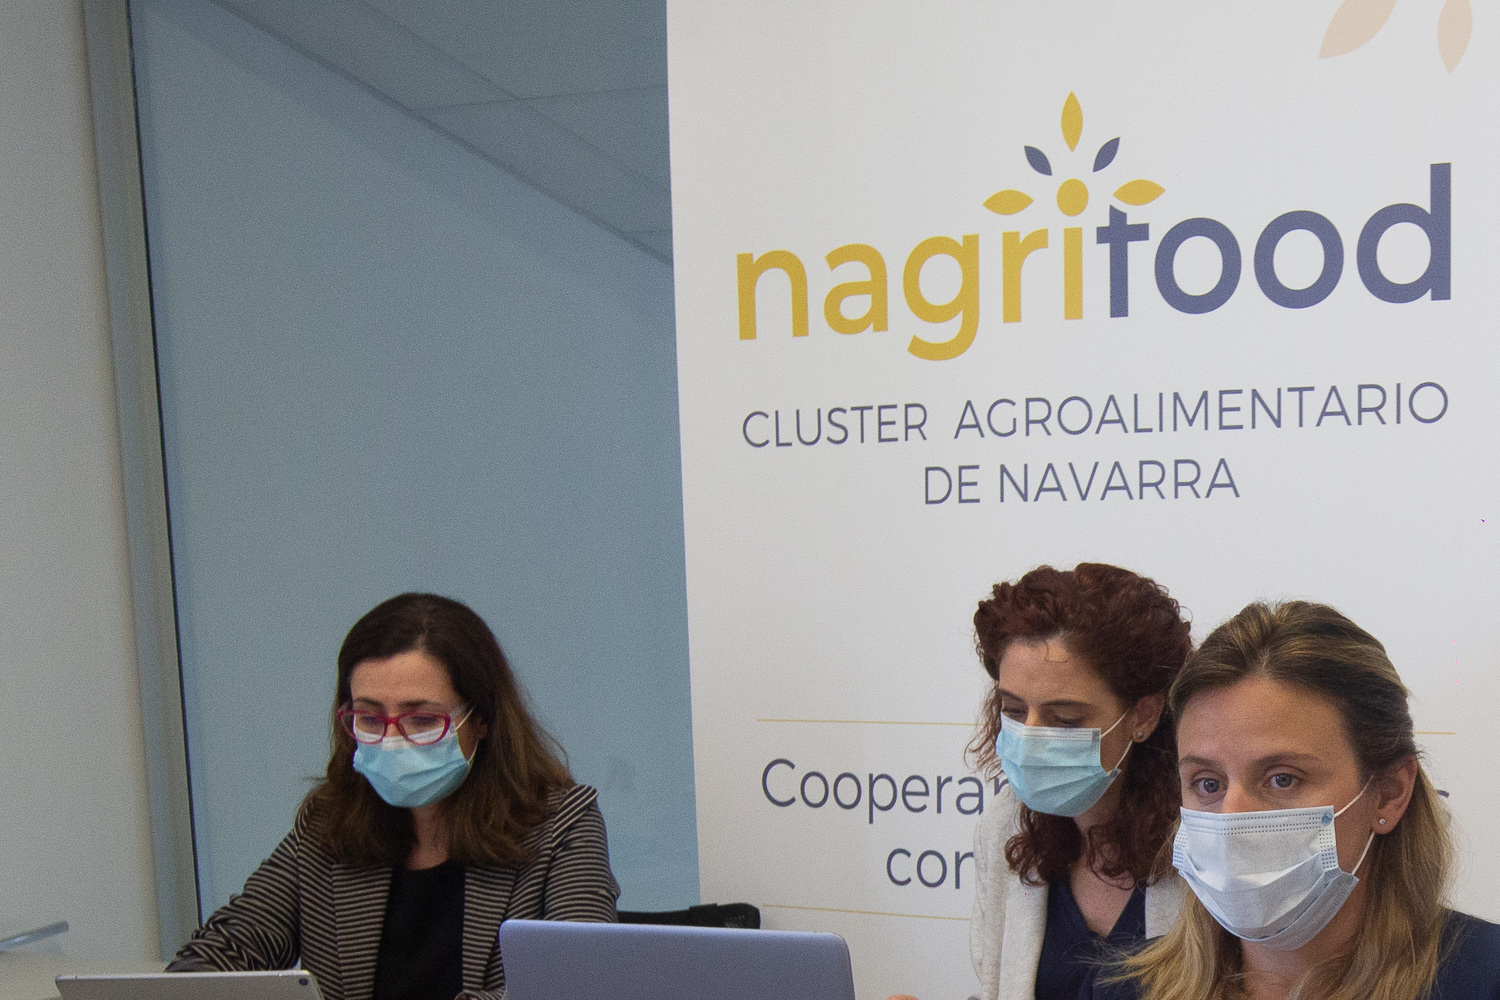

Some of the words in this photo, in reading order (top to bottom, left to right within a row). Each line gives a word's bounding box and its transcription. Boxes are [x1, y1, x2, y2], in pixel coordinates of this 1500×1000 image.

[736, 163, 1452, 361] nagrifood
[741, 403, 928, 448] CLUSTER
[953, 381, 1450, 439] AGROALIMENTARIO
[923, 463, 980, 506] DE
[999, 457, 1240, 504] NAVARRA
